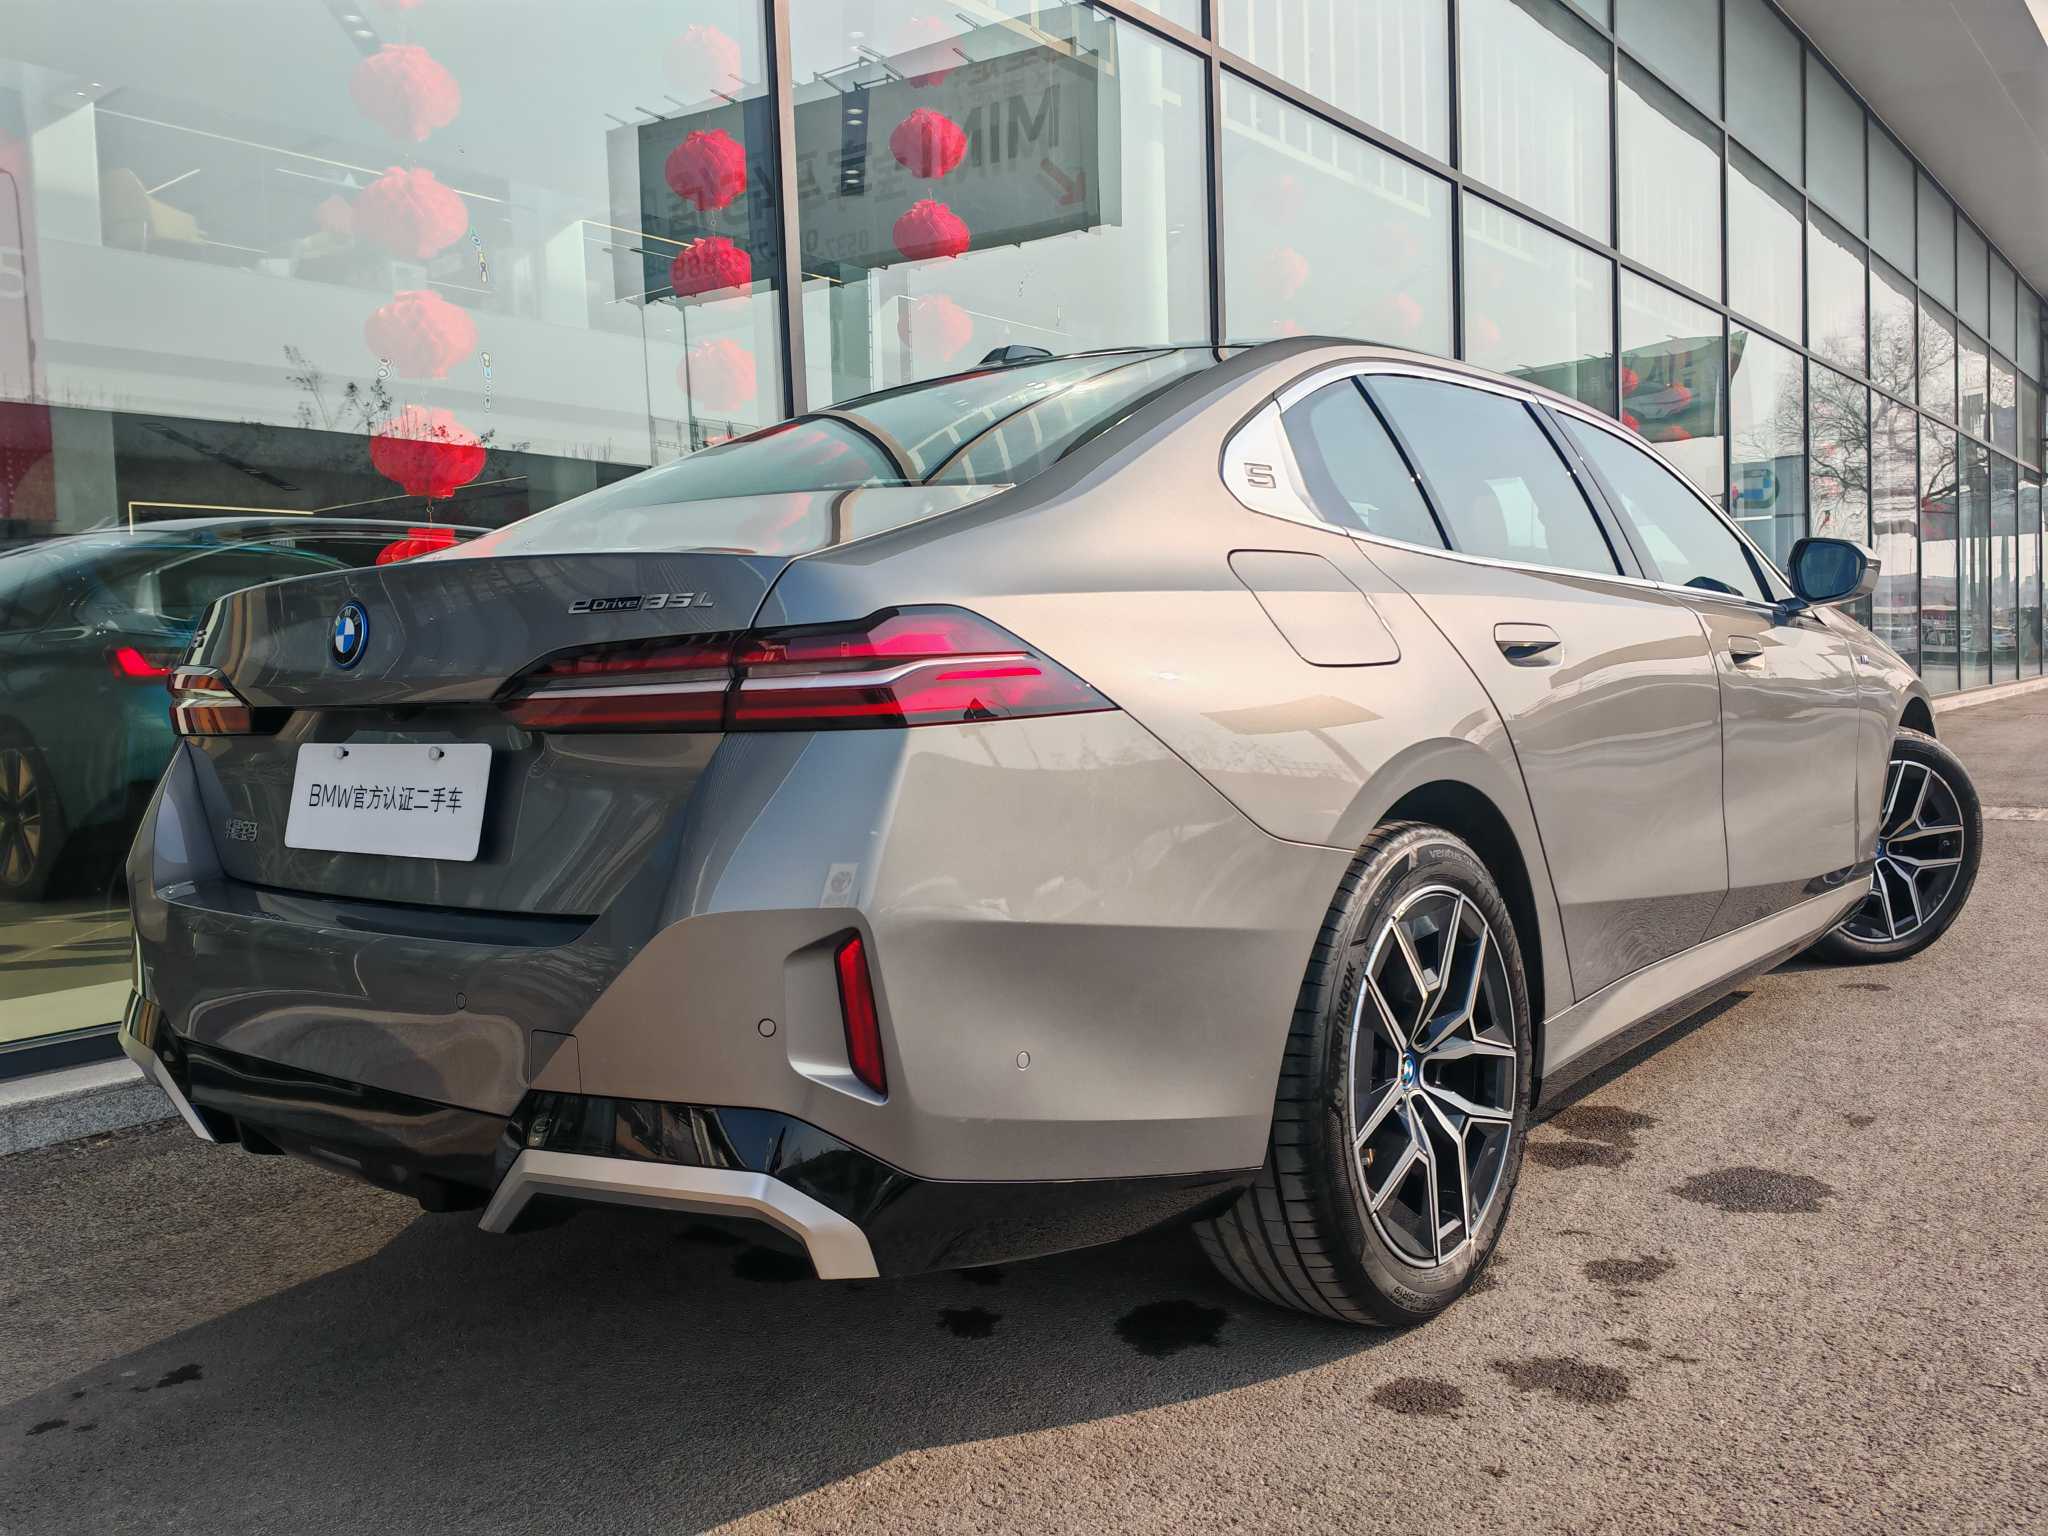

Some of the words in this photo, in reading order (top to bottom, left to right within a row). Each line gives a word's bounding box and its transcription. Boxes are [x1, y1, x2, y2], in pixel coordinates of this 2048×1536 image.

[308, 784, 463, 815] BMW官方认证二手车
